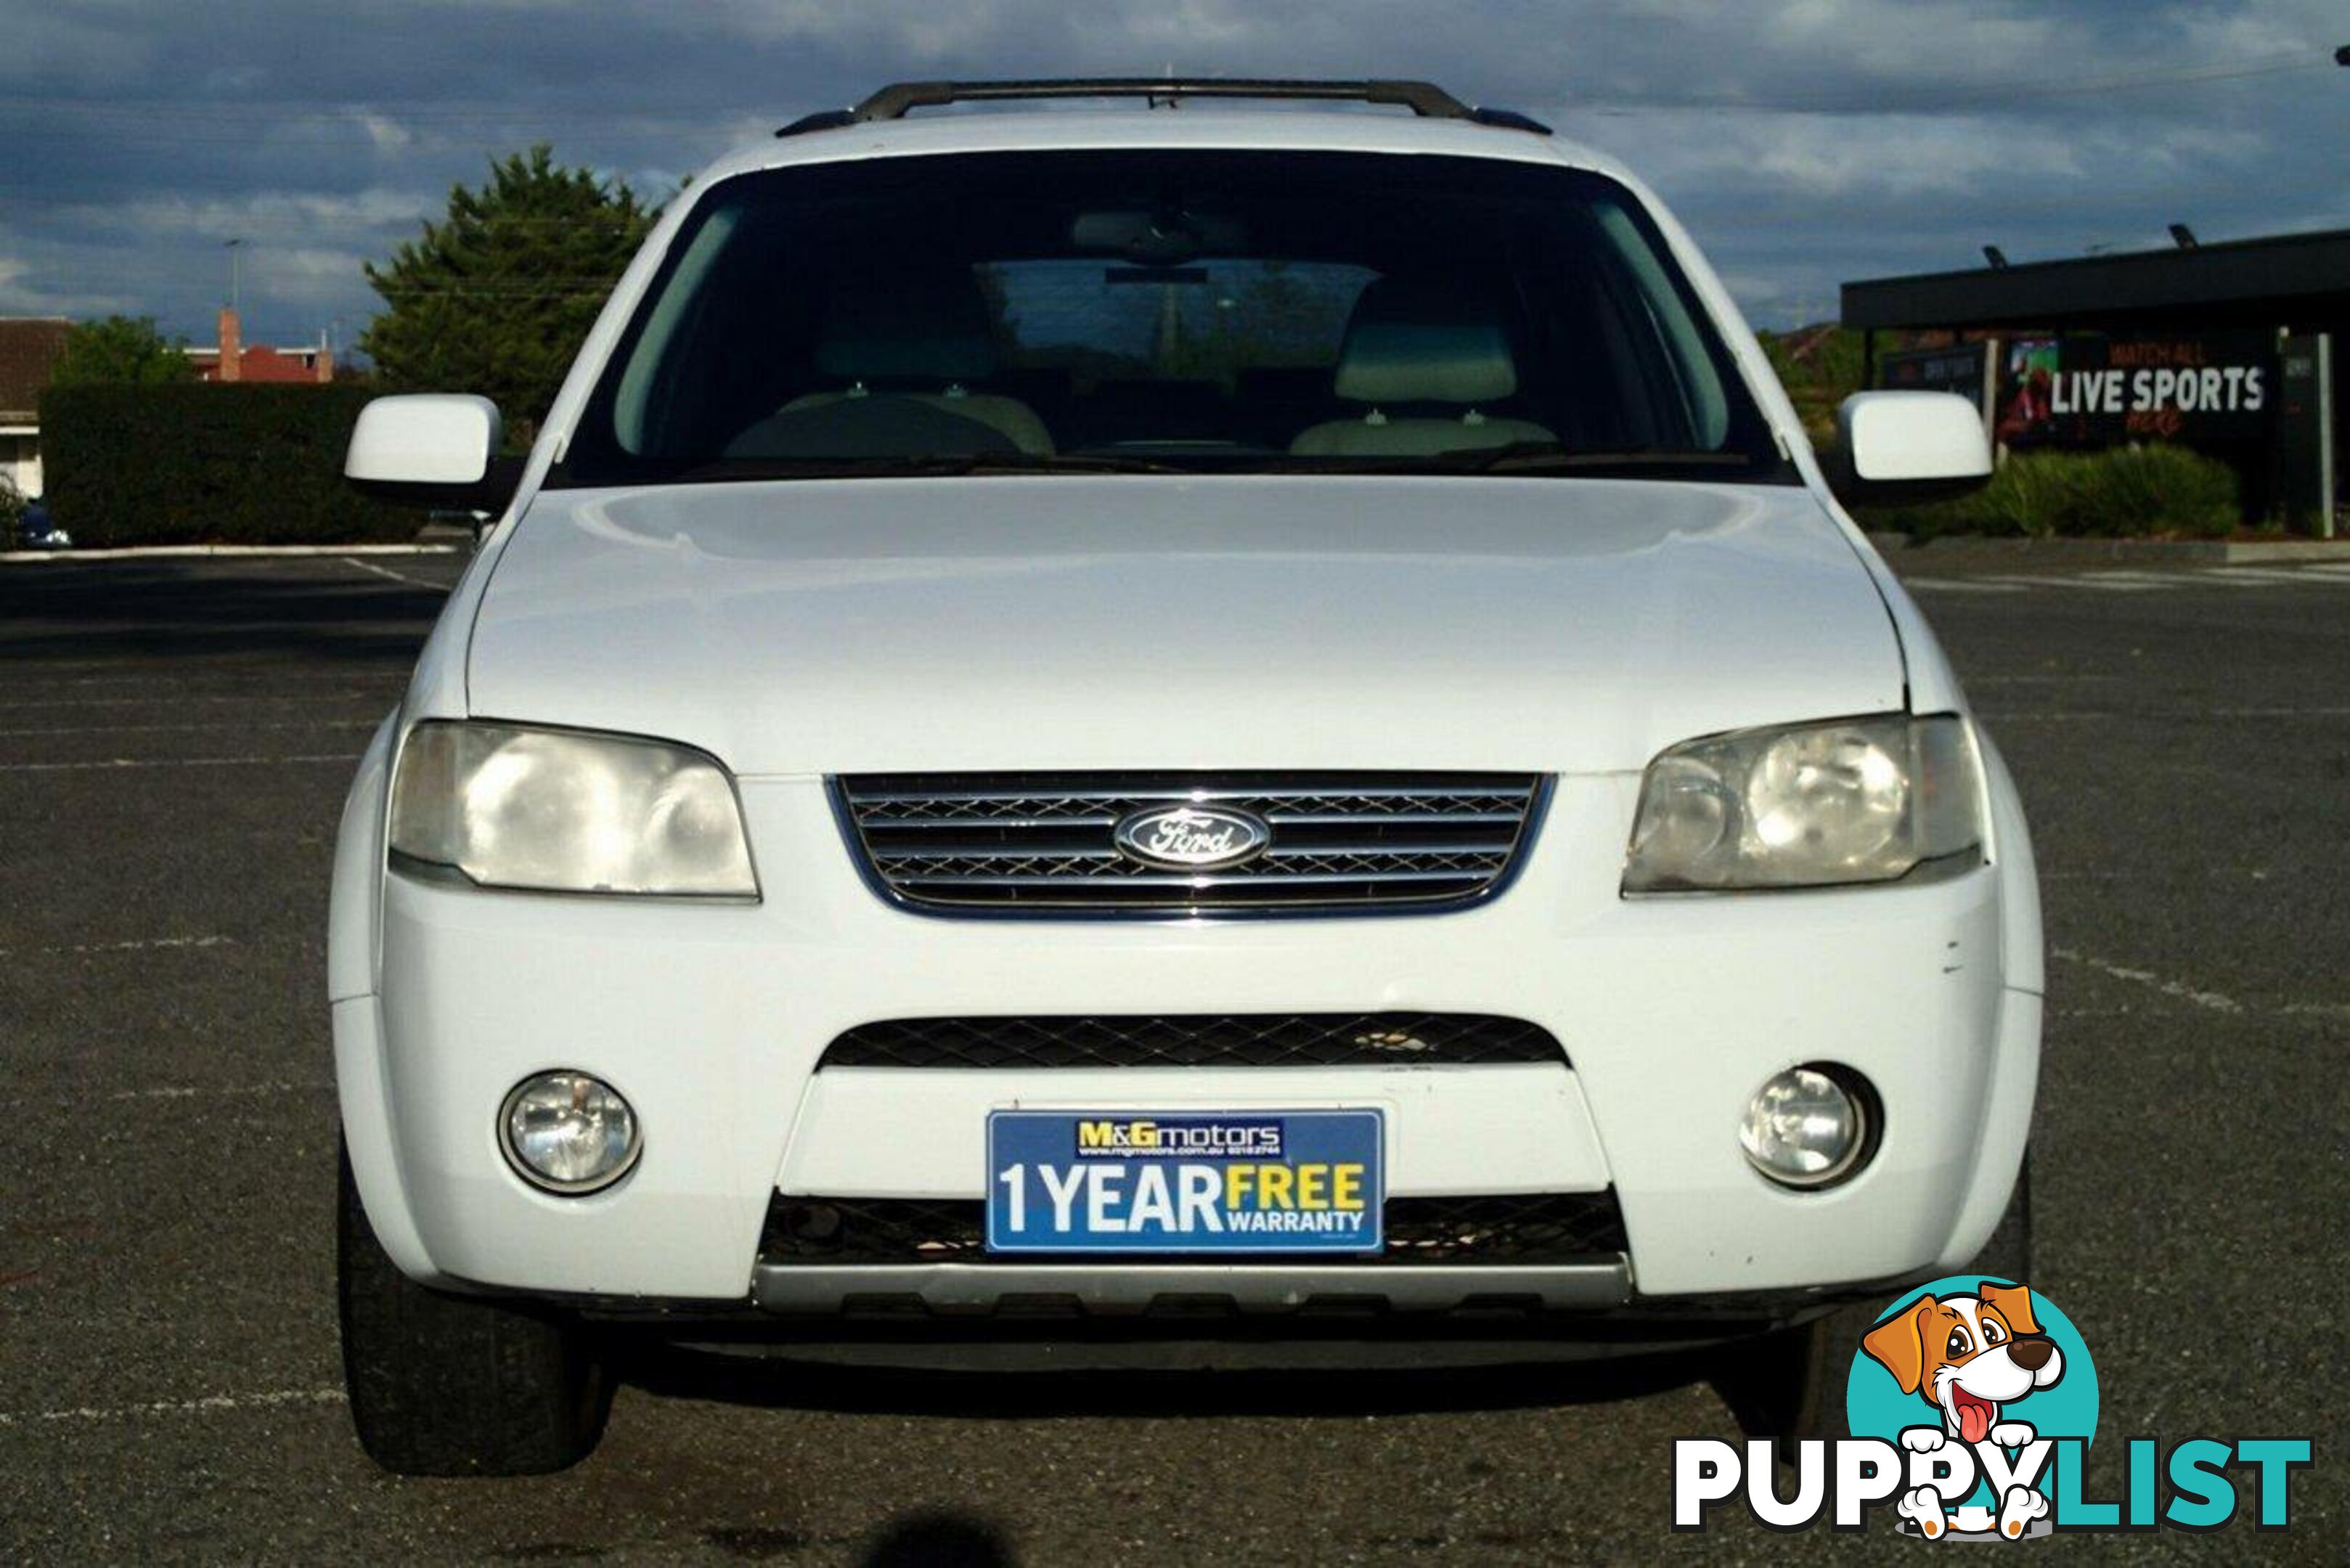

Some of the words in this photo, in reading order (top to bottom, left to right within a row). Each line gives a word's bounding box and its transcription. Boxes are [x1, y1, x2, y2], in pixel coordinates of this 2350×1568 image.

[2051, 370, 2124, 414] LIVE
[2131, 366, 2264, 412] SPORTS
[1150, 817, 1235, 853] Ford
[1079, 1122, 1279, 1146] M&Gmotors
[1000, 1164, 1024, 1231] 1
[1038, 1164, 1225, 1232] YEAR
[1227, 1165, 1364, 1209] FREE
[1228, 1212, 1363, 1231] WARRANTY
